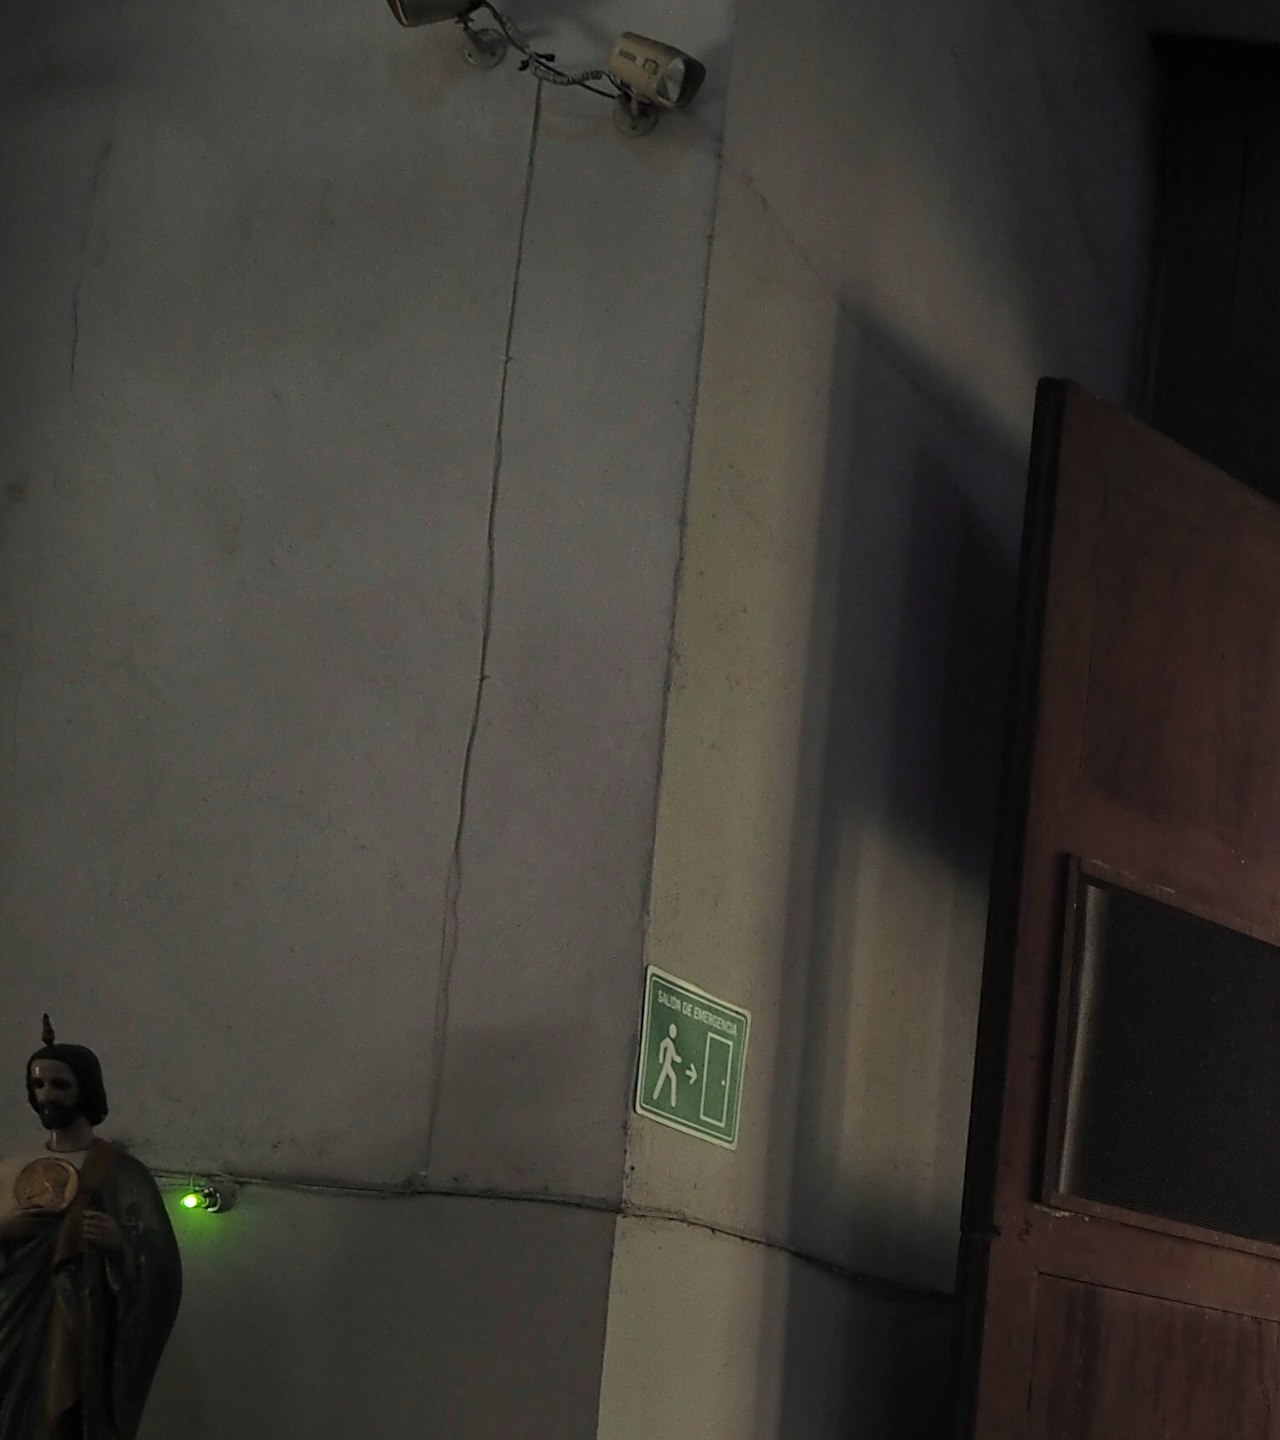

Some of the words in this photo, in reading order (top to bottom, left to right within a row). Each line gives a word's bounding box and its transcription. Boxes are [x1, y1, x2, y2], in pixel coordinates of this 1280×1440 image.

[657, 990, 681, 1012] SALIDA
[682, 1001, 693, 1017] DE
[694, 1006, 738, 1036] EMERGENCIA
